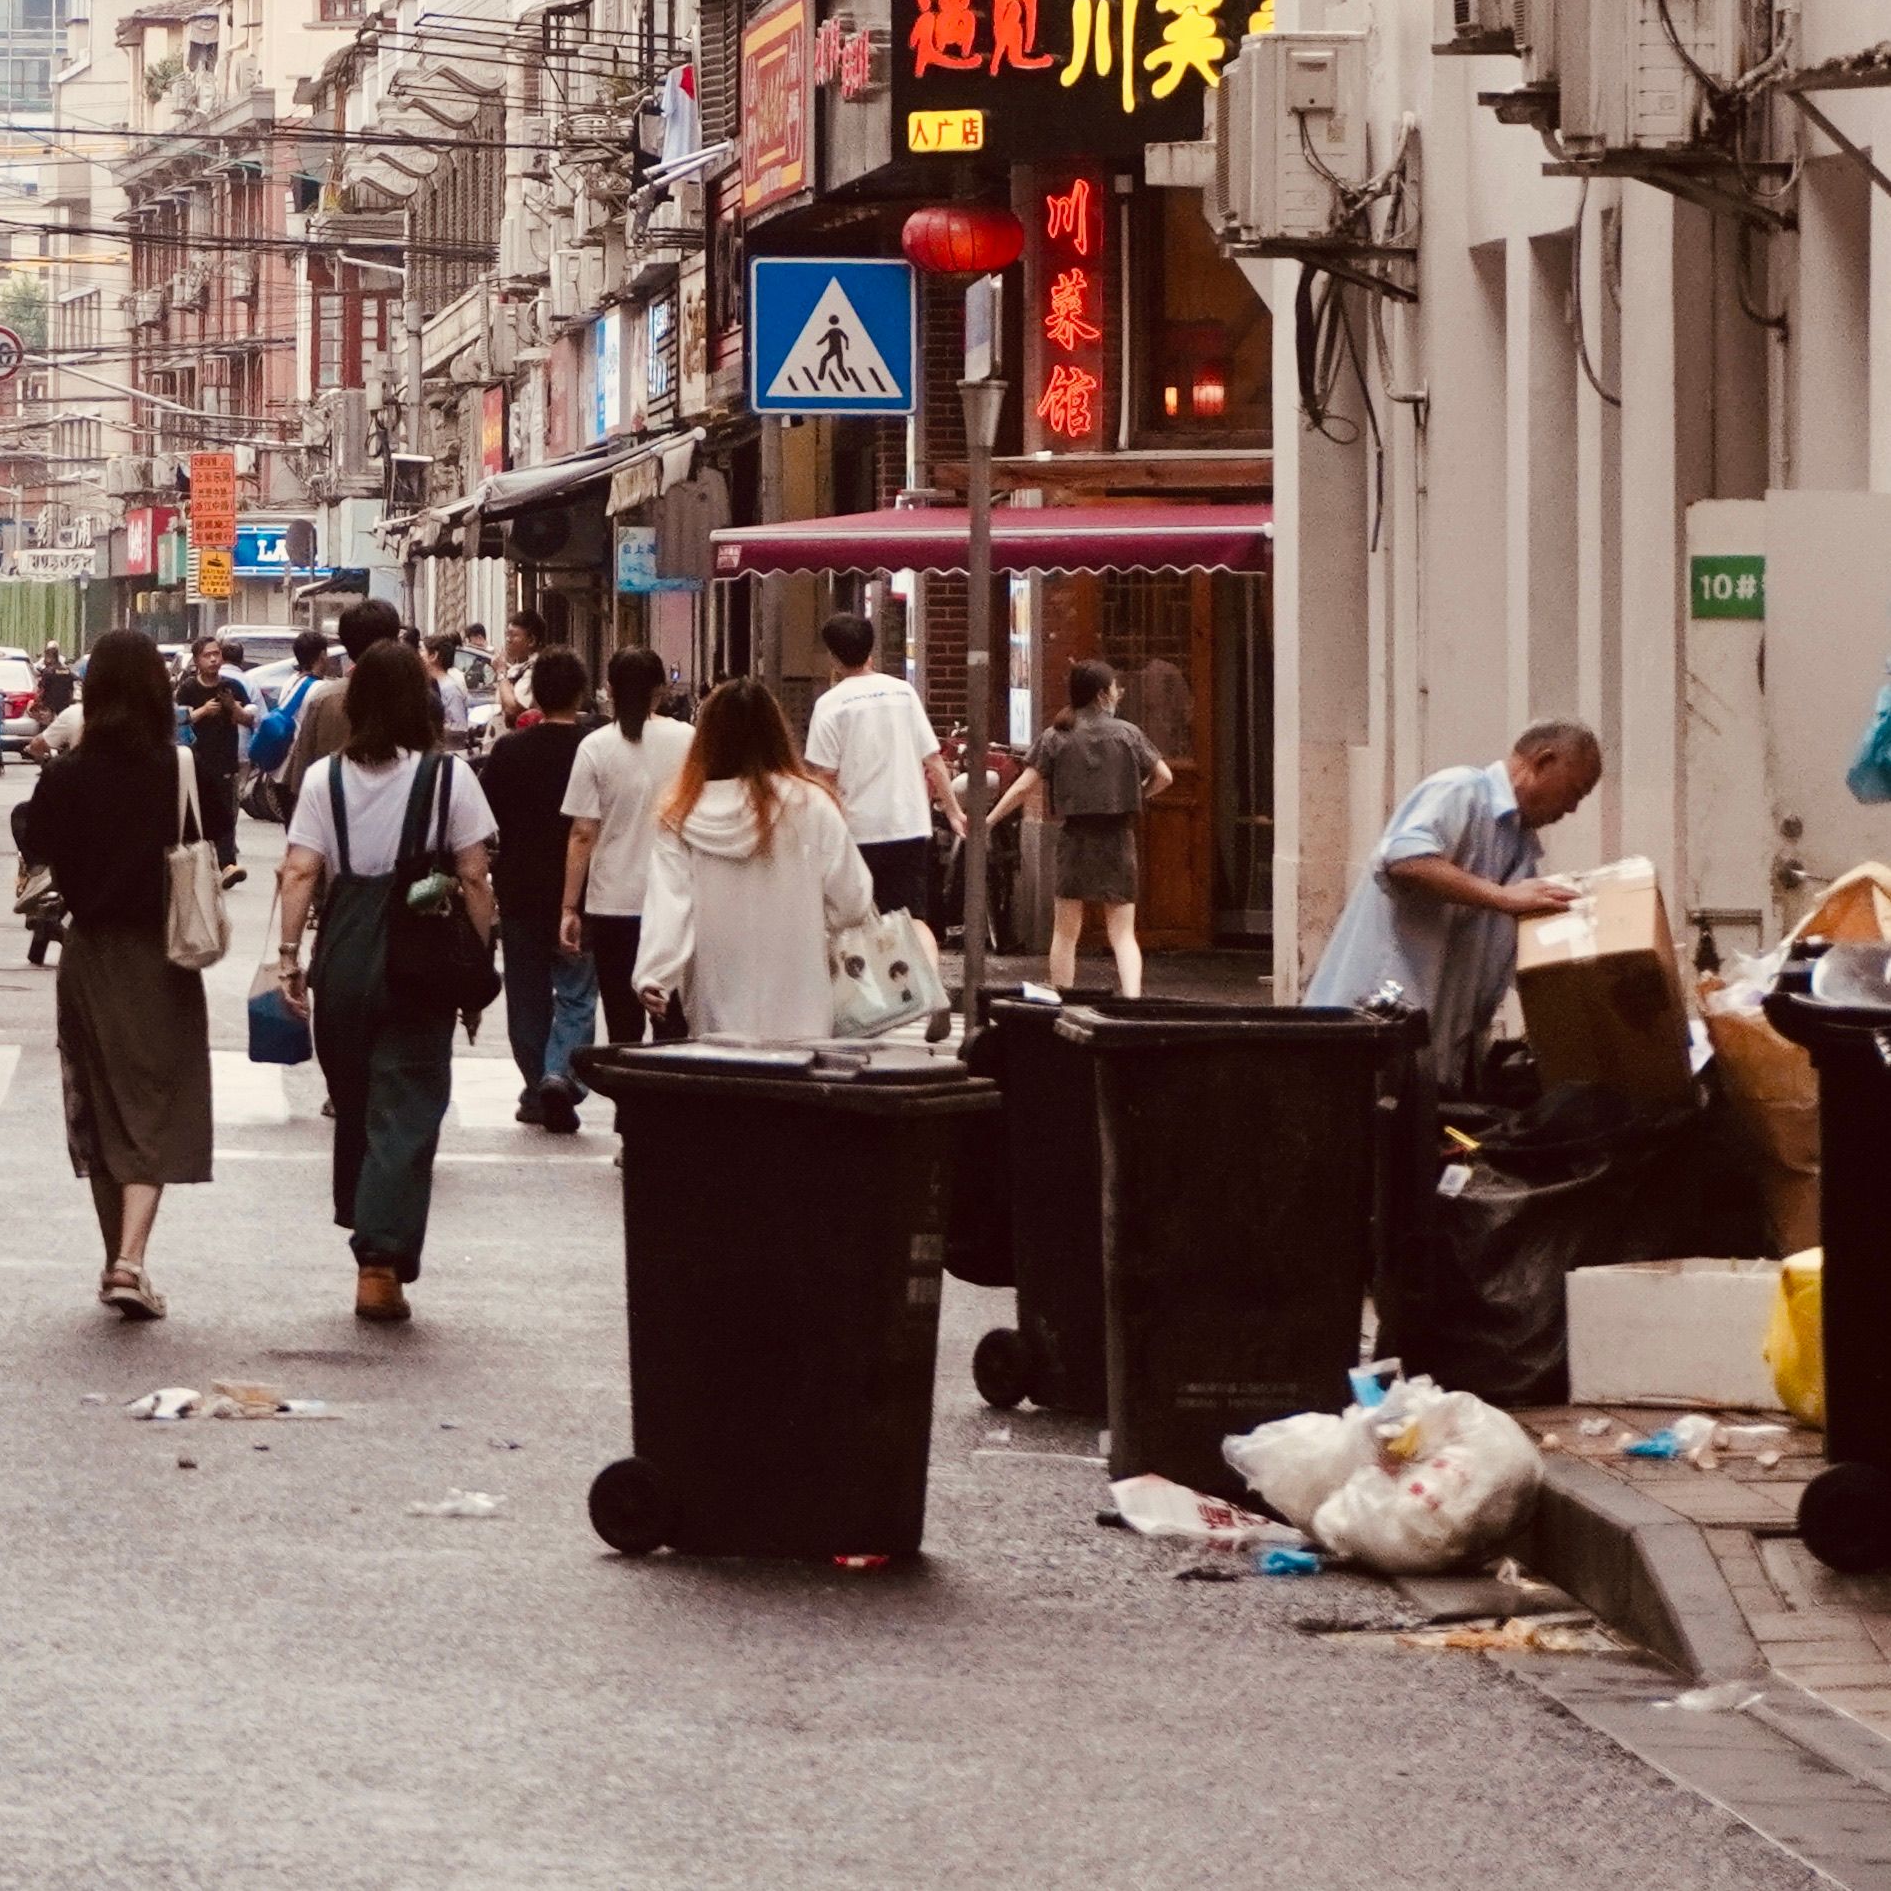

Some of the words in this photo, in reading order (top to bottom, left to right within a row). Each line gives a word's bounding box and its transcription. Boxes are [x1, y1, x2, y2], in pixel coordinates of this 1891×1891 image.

[911, 117, 980, 146] 人广店
[1037, 178, 1101, 438] 川菜馆
[1700, 573, 1764, 600] 10#
